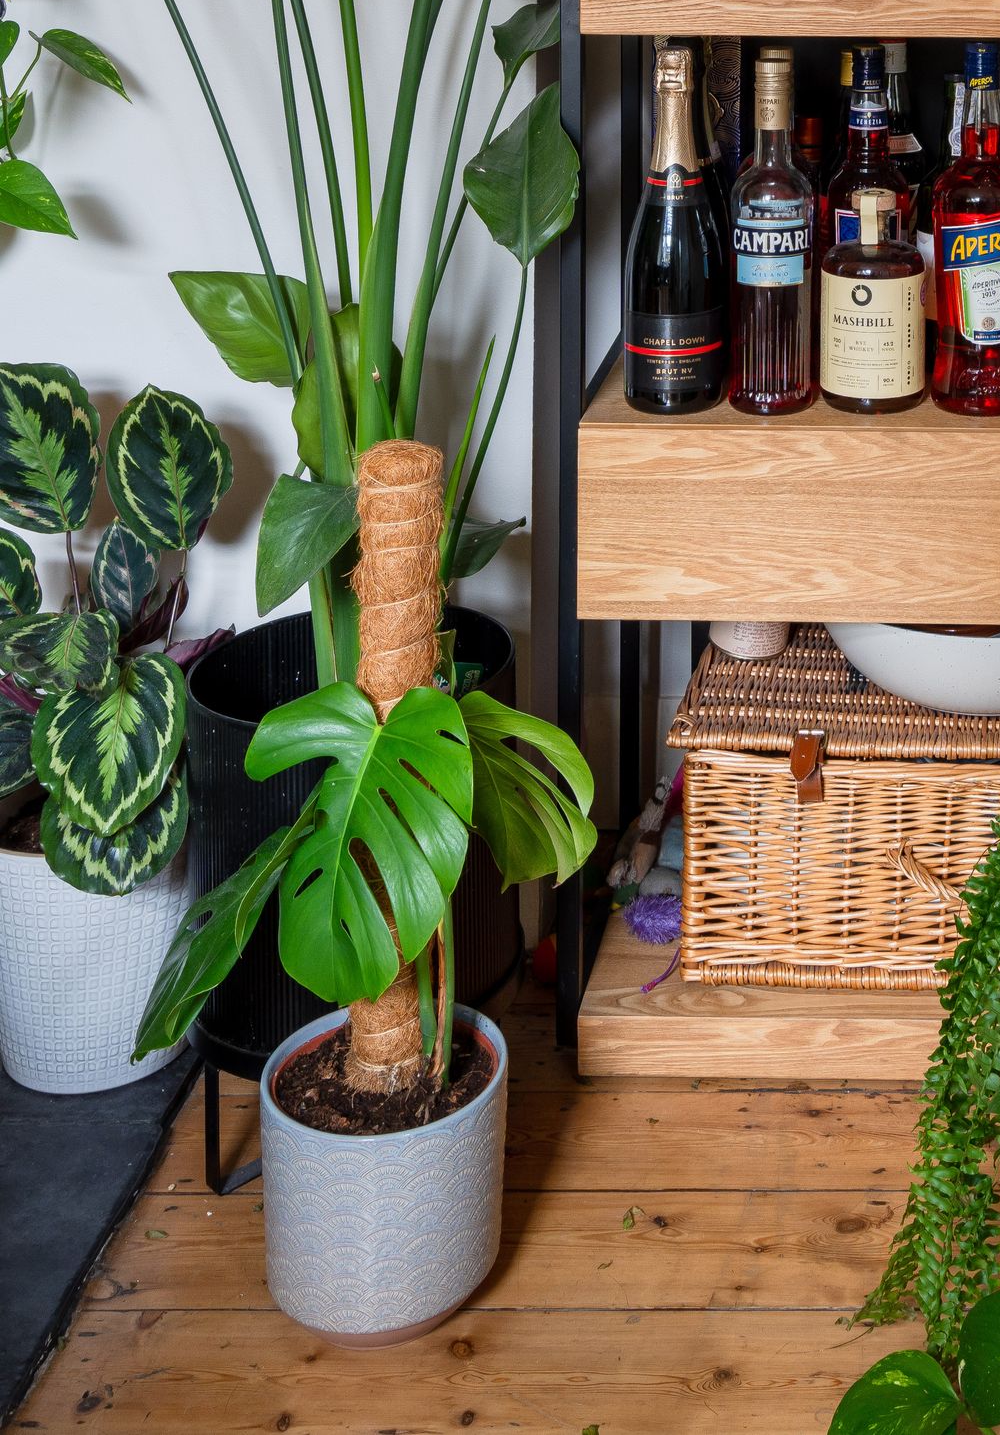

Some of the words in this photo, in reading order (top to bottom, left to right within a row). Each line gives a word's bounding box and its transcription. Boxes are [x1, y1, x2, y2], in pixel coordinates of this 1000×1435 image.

[970, 76, 993, 87] APEROL
[856, 117, 882, 125] VENEZIA
[733, 228, 810, 254] CAMPARI
[982, 290, 996, 299] 1919
[833, 314, 894, 327] MASHBILL
[643, 337, 676, 346] CHAPEL
[679, 336, 705, 345] DOWN
